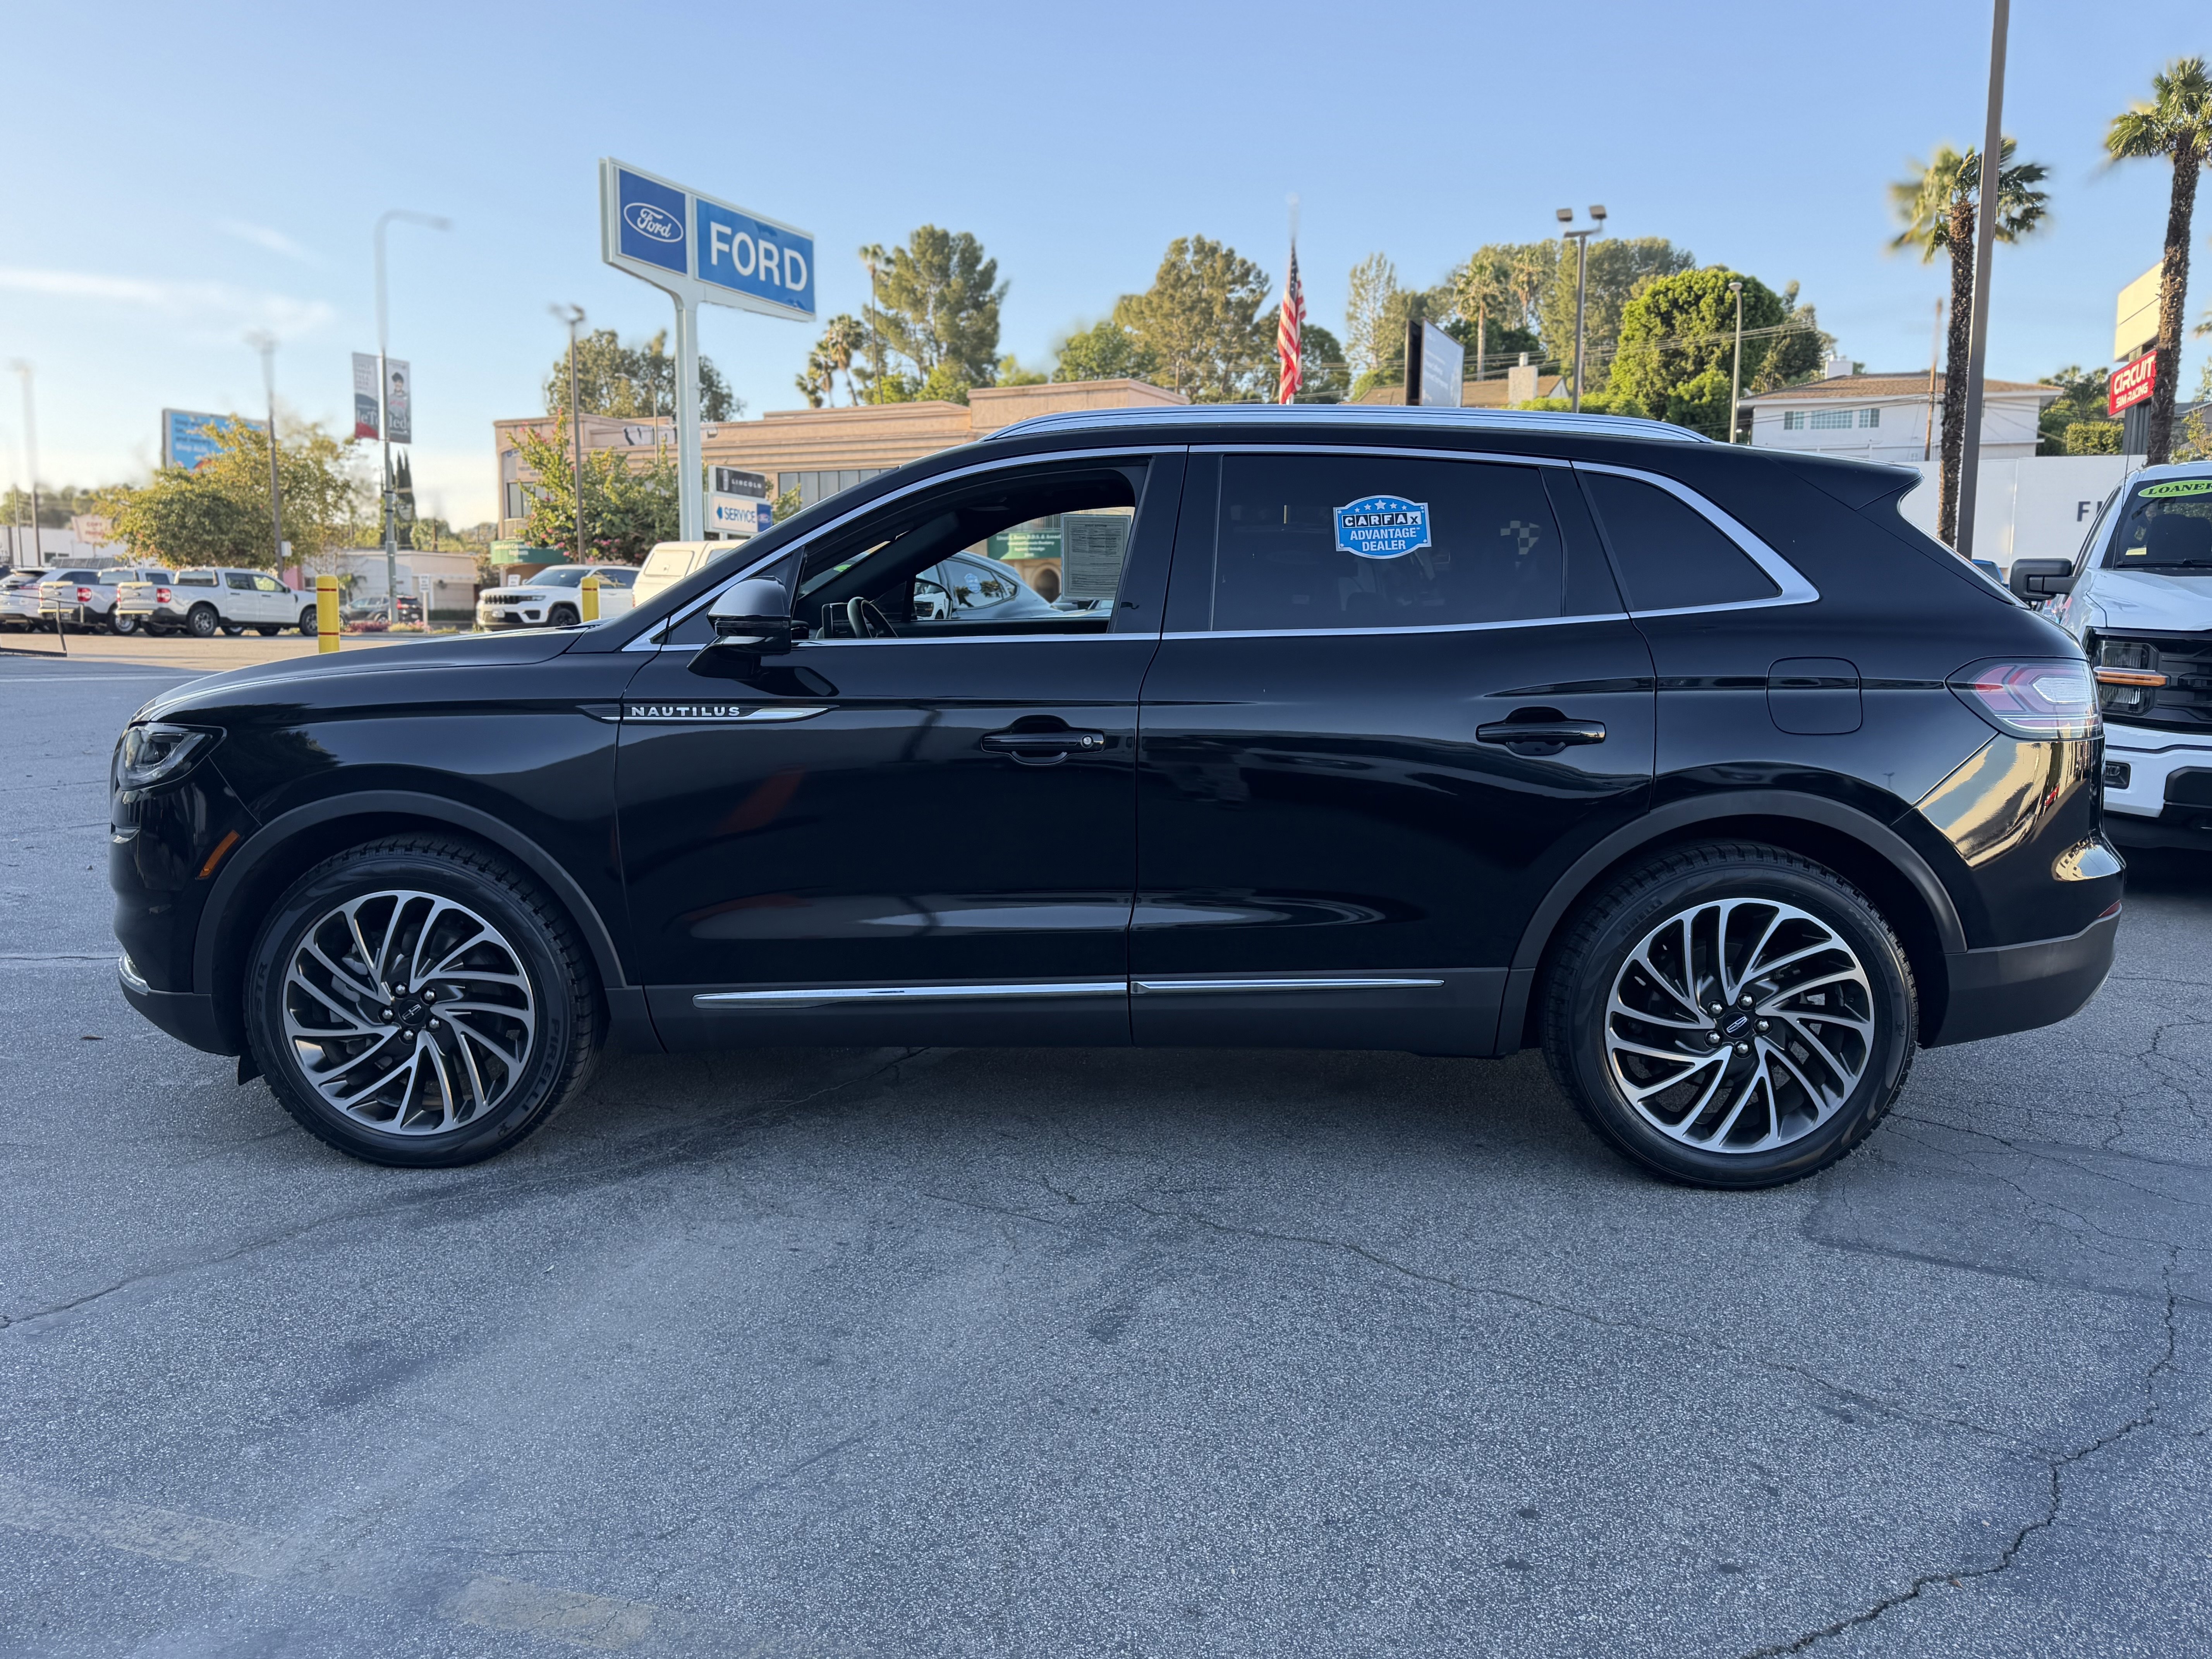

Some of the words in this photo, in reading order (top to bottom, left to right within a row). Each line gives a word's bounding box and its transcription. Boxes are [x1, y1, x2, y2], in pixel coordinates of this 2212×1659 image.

[637, 208, 672, 238] Ford
[710, 221, 807, 292] FORD
[2114, 355, 2156, 395] CIRCUIT
[2116, 394, 2126, 409] SIM
[2127, 382, 2148, 403] RACING
[732, 478, 762, 489] LINCOLN
[724, 507, 756, 523] SERVICE
[1345, 514, 1419, 526] CARFAX
[1362, 540, 1406, 551] DEALER
[631, 707, 740, 716] NAUTILUS
[522, 1018, 560, 1112] PIRELLI
